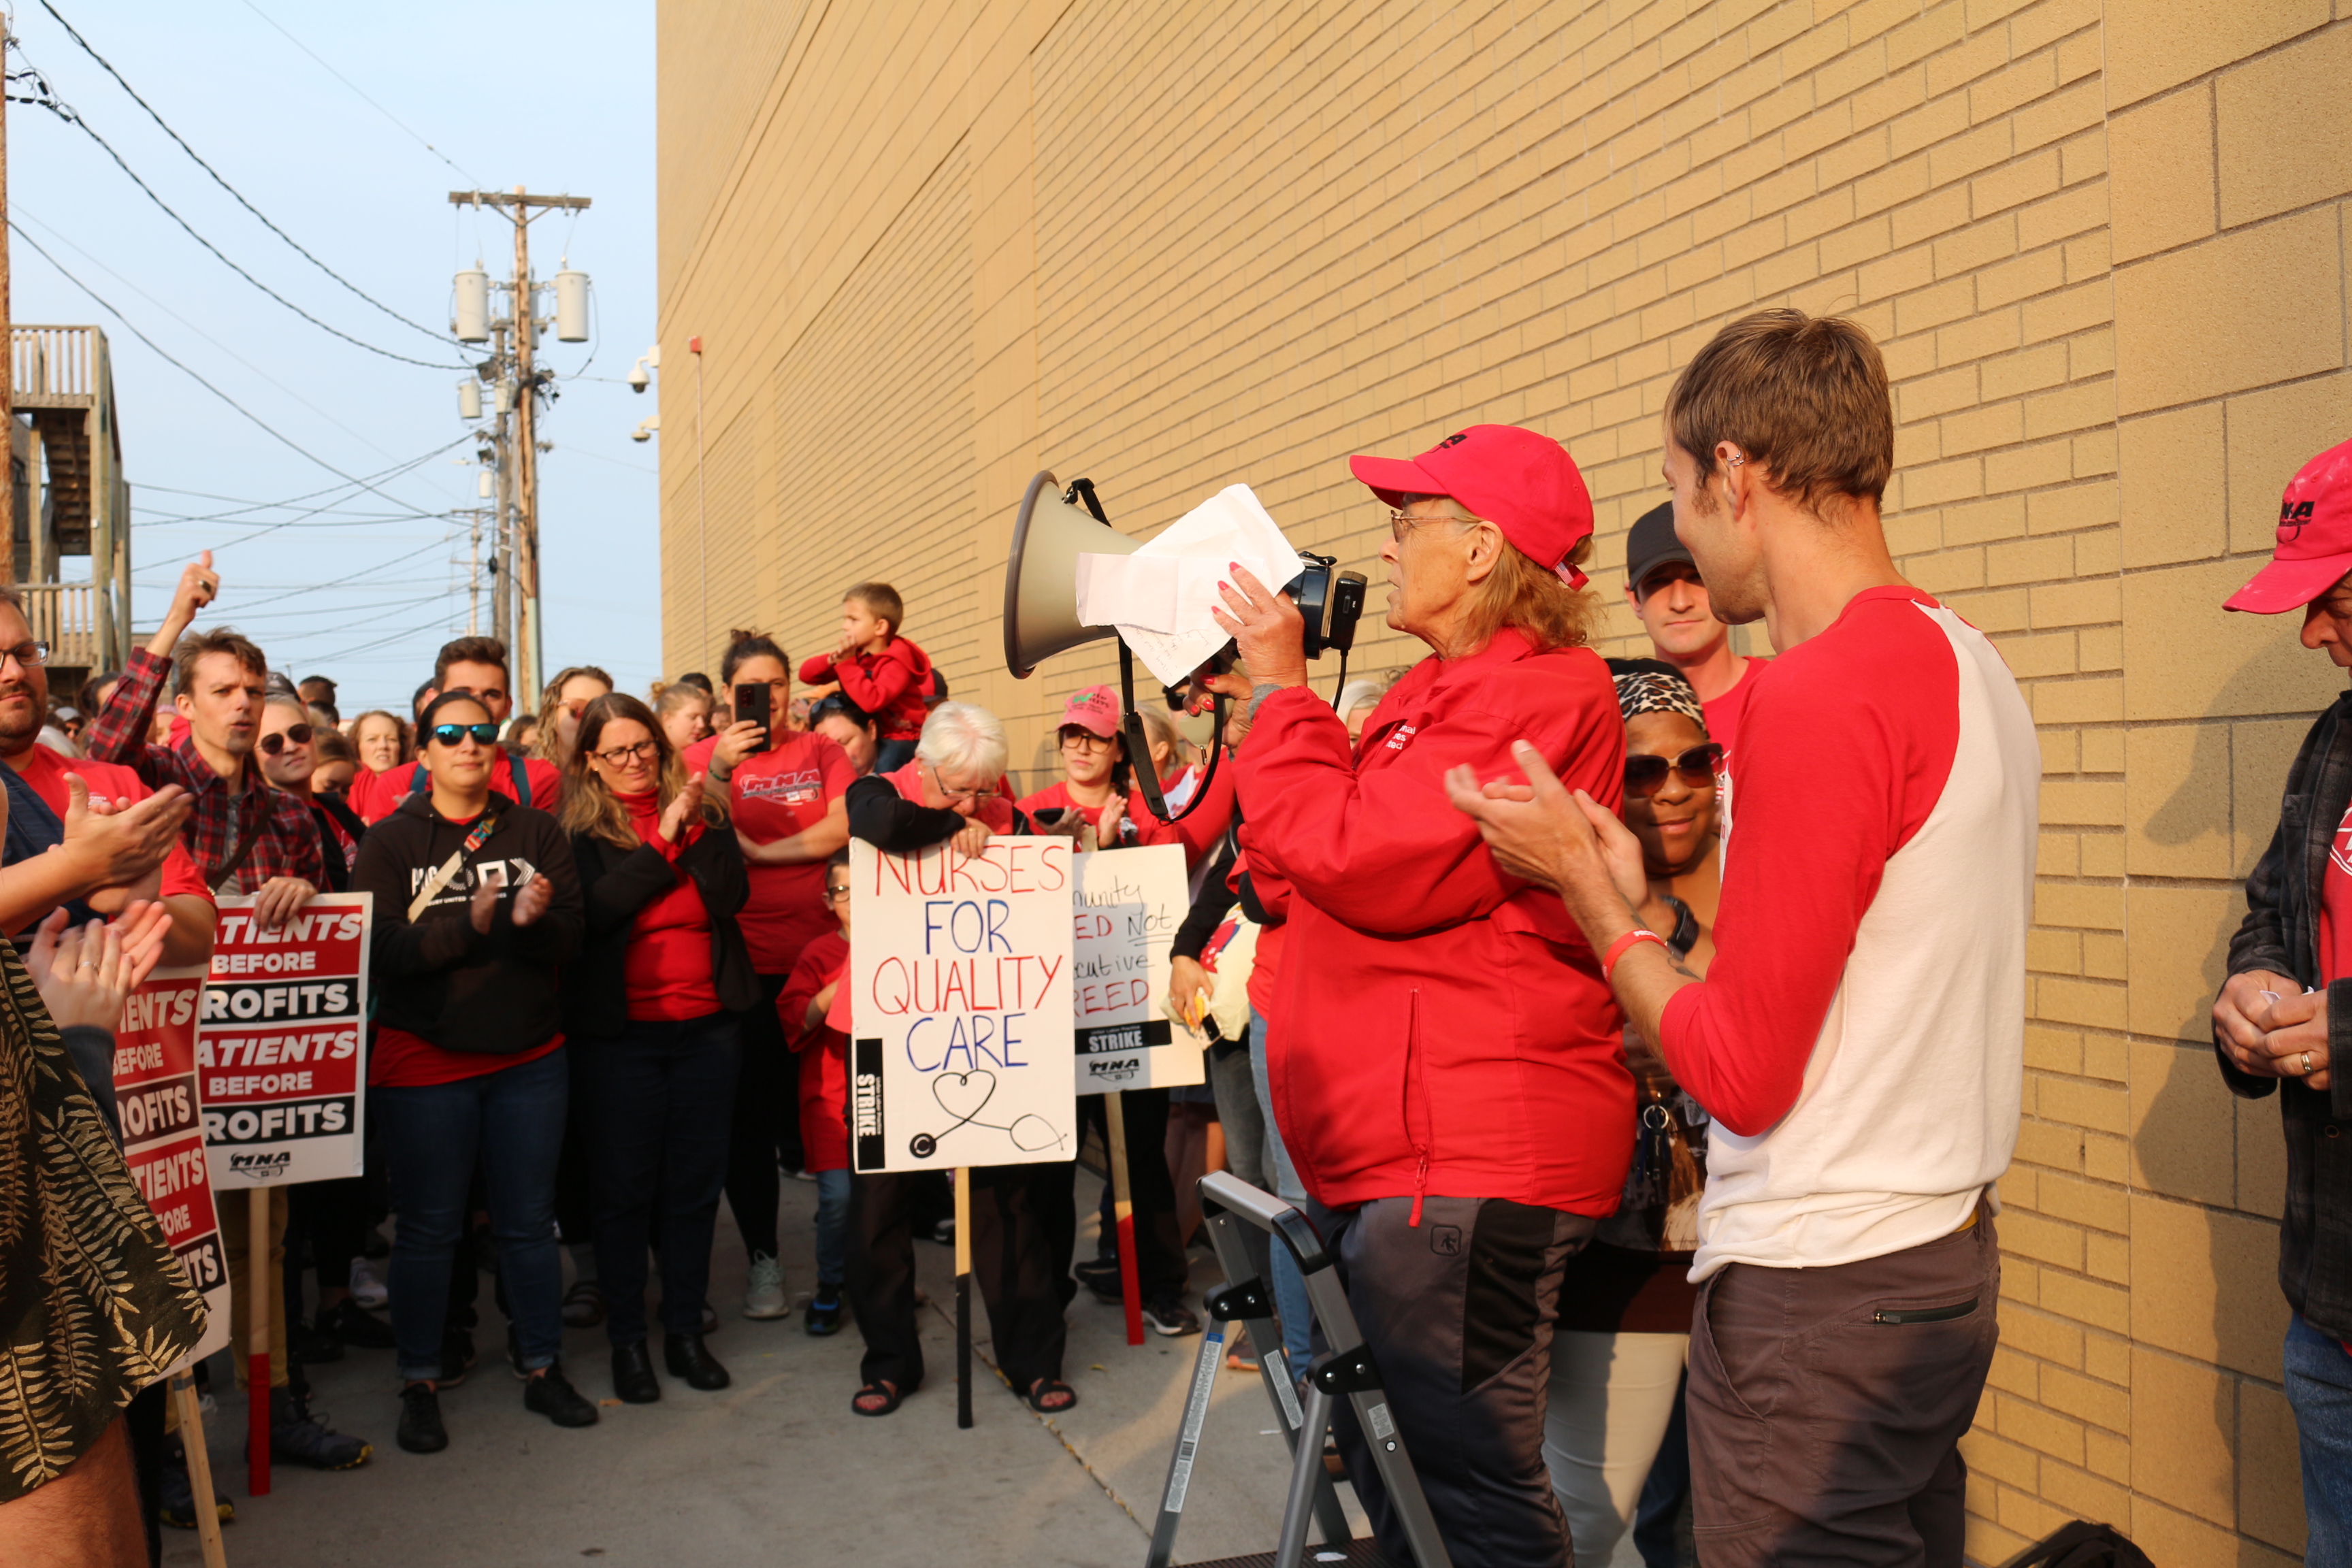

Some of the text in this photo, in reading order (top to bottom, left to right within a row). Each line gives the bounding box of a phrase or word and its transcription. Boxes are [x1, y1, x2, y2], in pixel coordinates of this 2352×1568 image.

[876, 845, 1064, 896] NURSES
[214, 913, 363, 945] TIENTS
[926, 899, 1012, 955] FOR
[211, 951, 316, 975] BEFORE
[201, 983, 349, 1019] ROFITS
[873, 955, 1063, 1015] QUALITY
[199, 1030, 357, 1068] ATIENTS
[906, 1013, 1028, 1073] CARE
[1089, 1030, 1143, 1053] STRIKE
[209, 1071, 313, 1097] BEFORE
[202, 1102, 346, 1142] ROFITS
[857, 1073, 877, 1137] STRIKE
